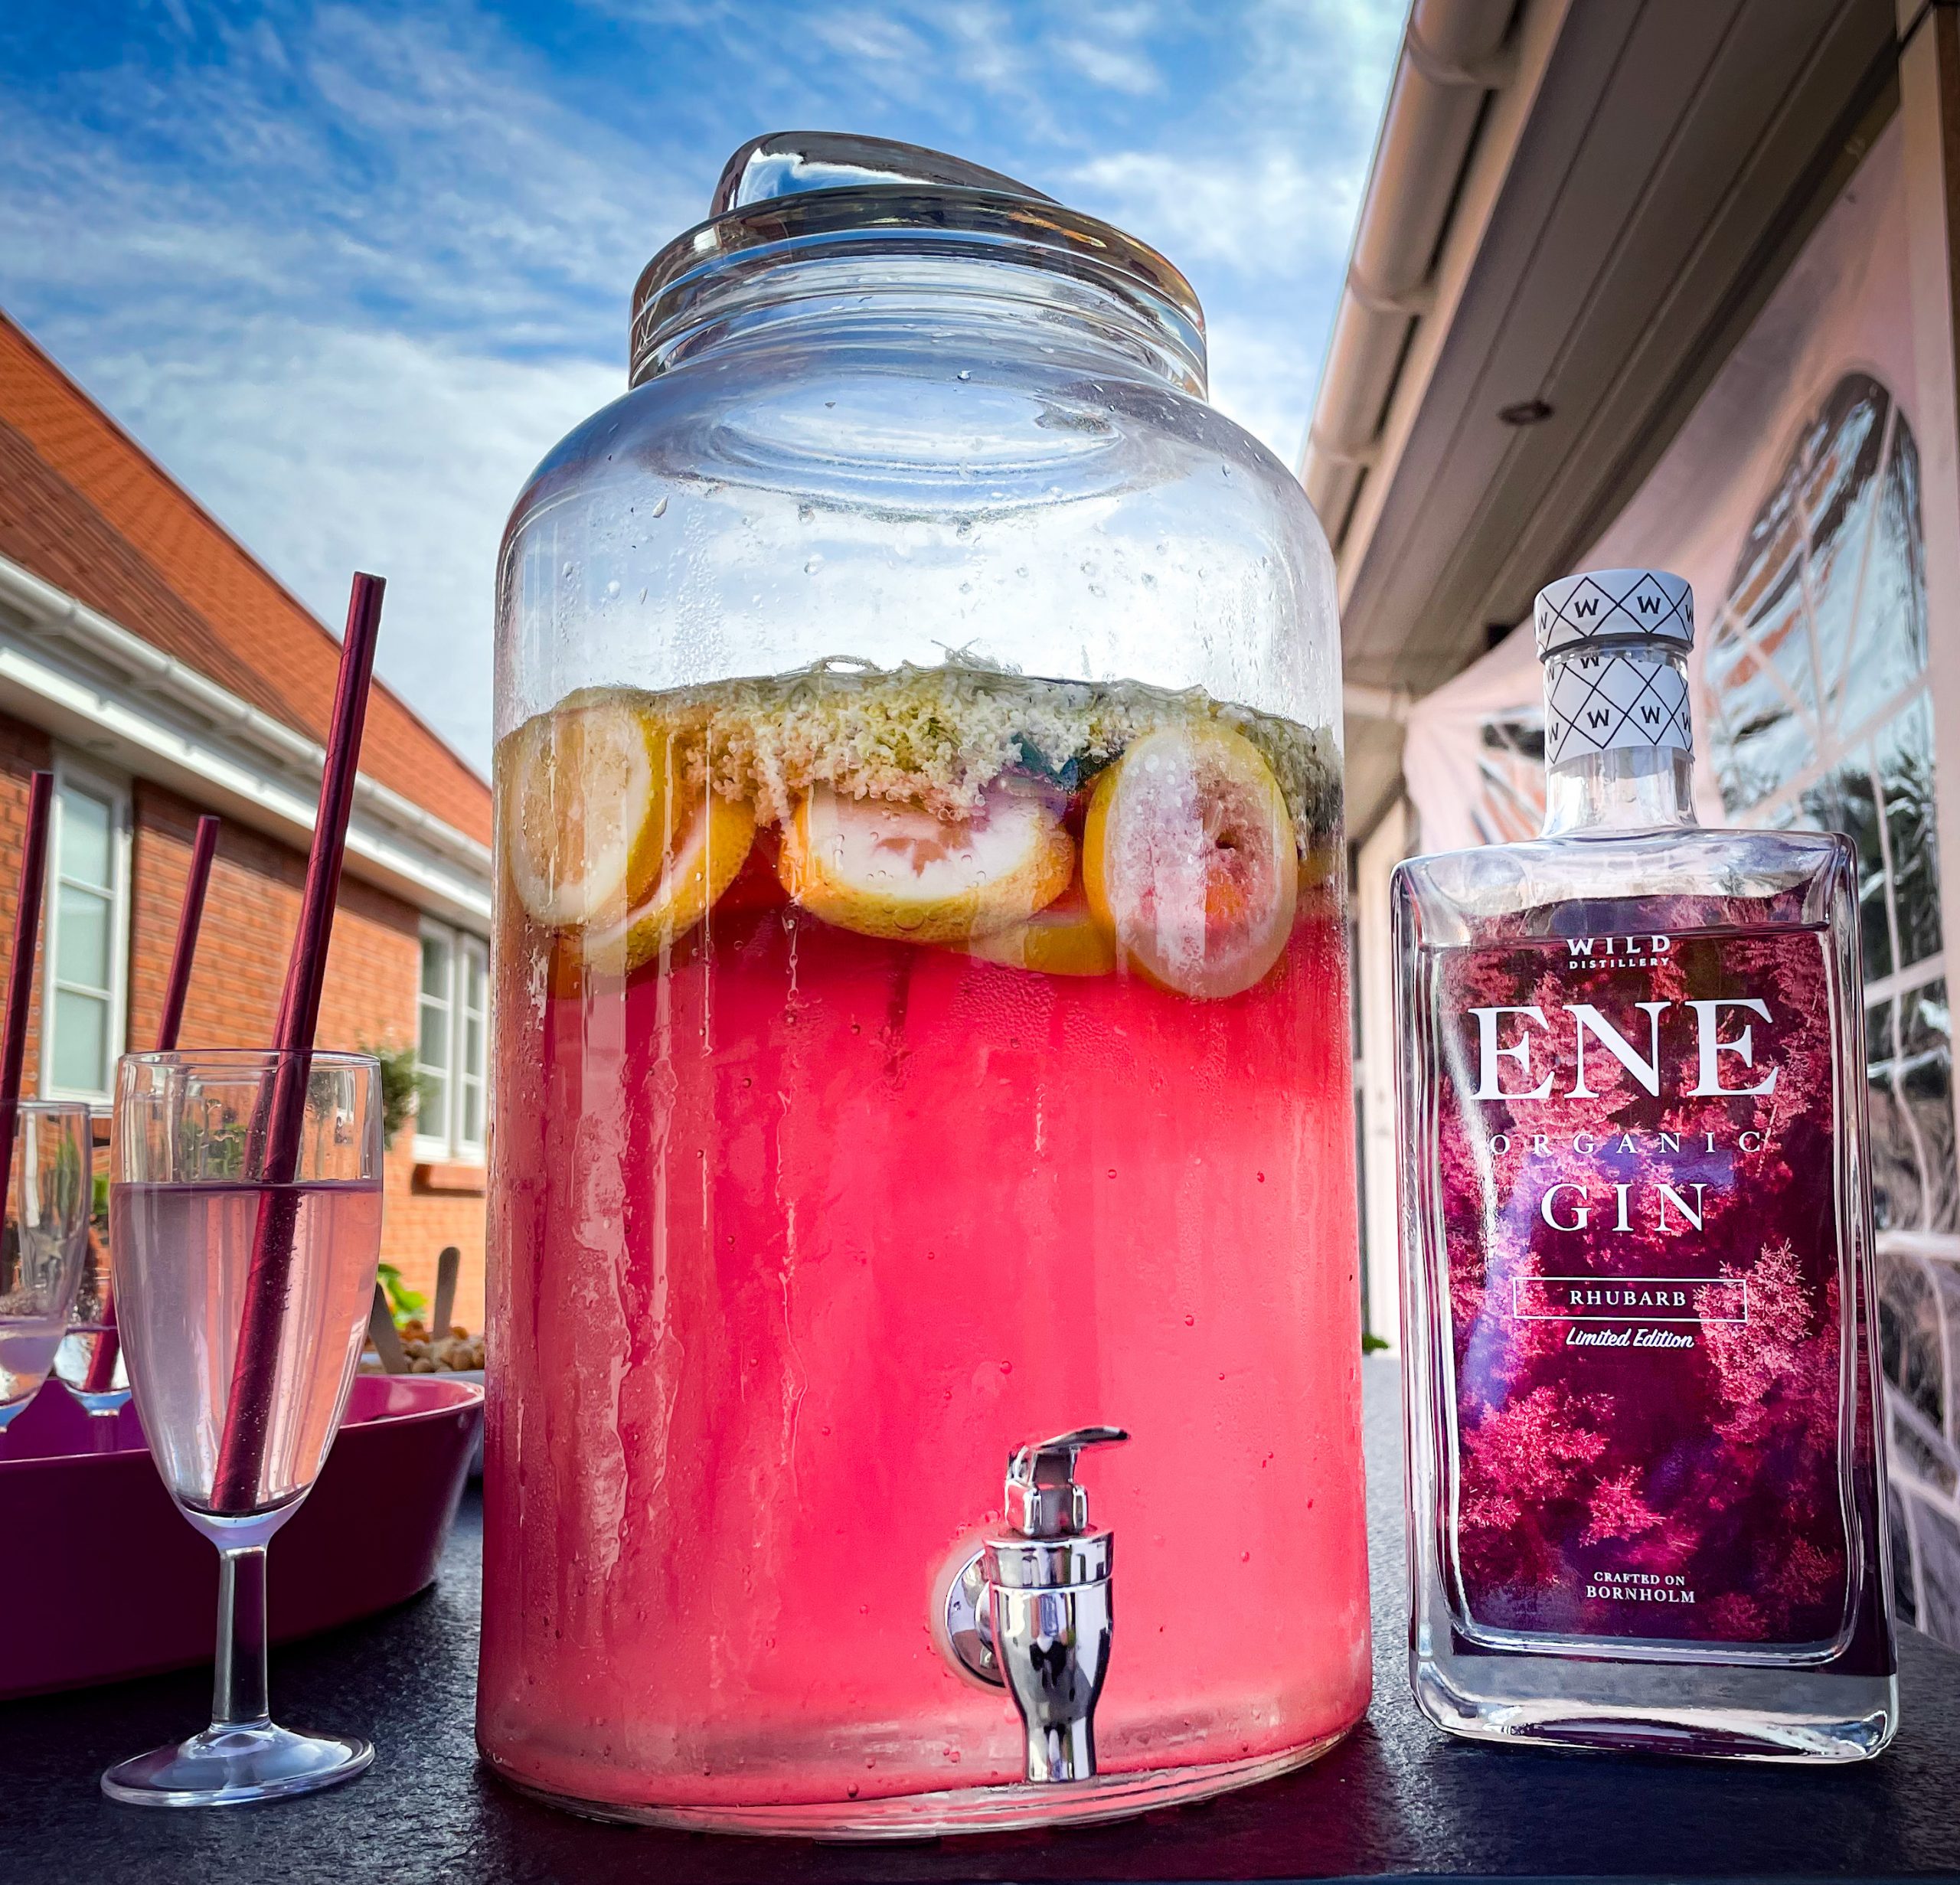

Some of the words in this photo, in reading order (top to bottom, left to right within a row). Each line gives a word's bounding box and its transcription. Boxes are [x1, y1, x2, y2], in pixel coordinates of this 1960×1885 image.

[1566, 935, 1671, 956] WILD
[1569, 957, 1670, 970] DISTILLERY
[1468, 998, 1779, 1101] ENE
[1488, 1131, 1762, 1155] ORGANIC
[1540, 1183, 1707, 1232] GIN
[1570, 1289, 1687, 1307] RHUBARB
[1566, 1327, 1630, 1348] Limited
[1633, 1328, 1695, 1349] Edition
[1593, 1571, 1661, 1585] CRAFTED
[1664, 1575, 1685, 1586] ON
[1586, 1585, 1696, 1603] BORNHOLM
